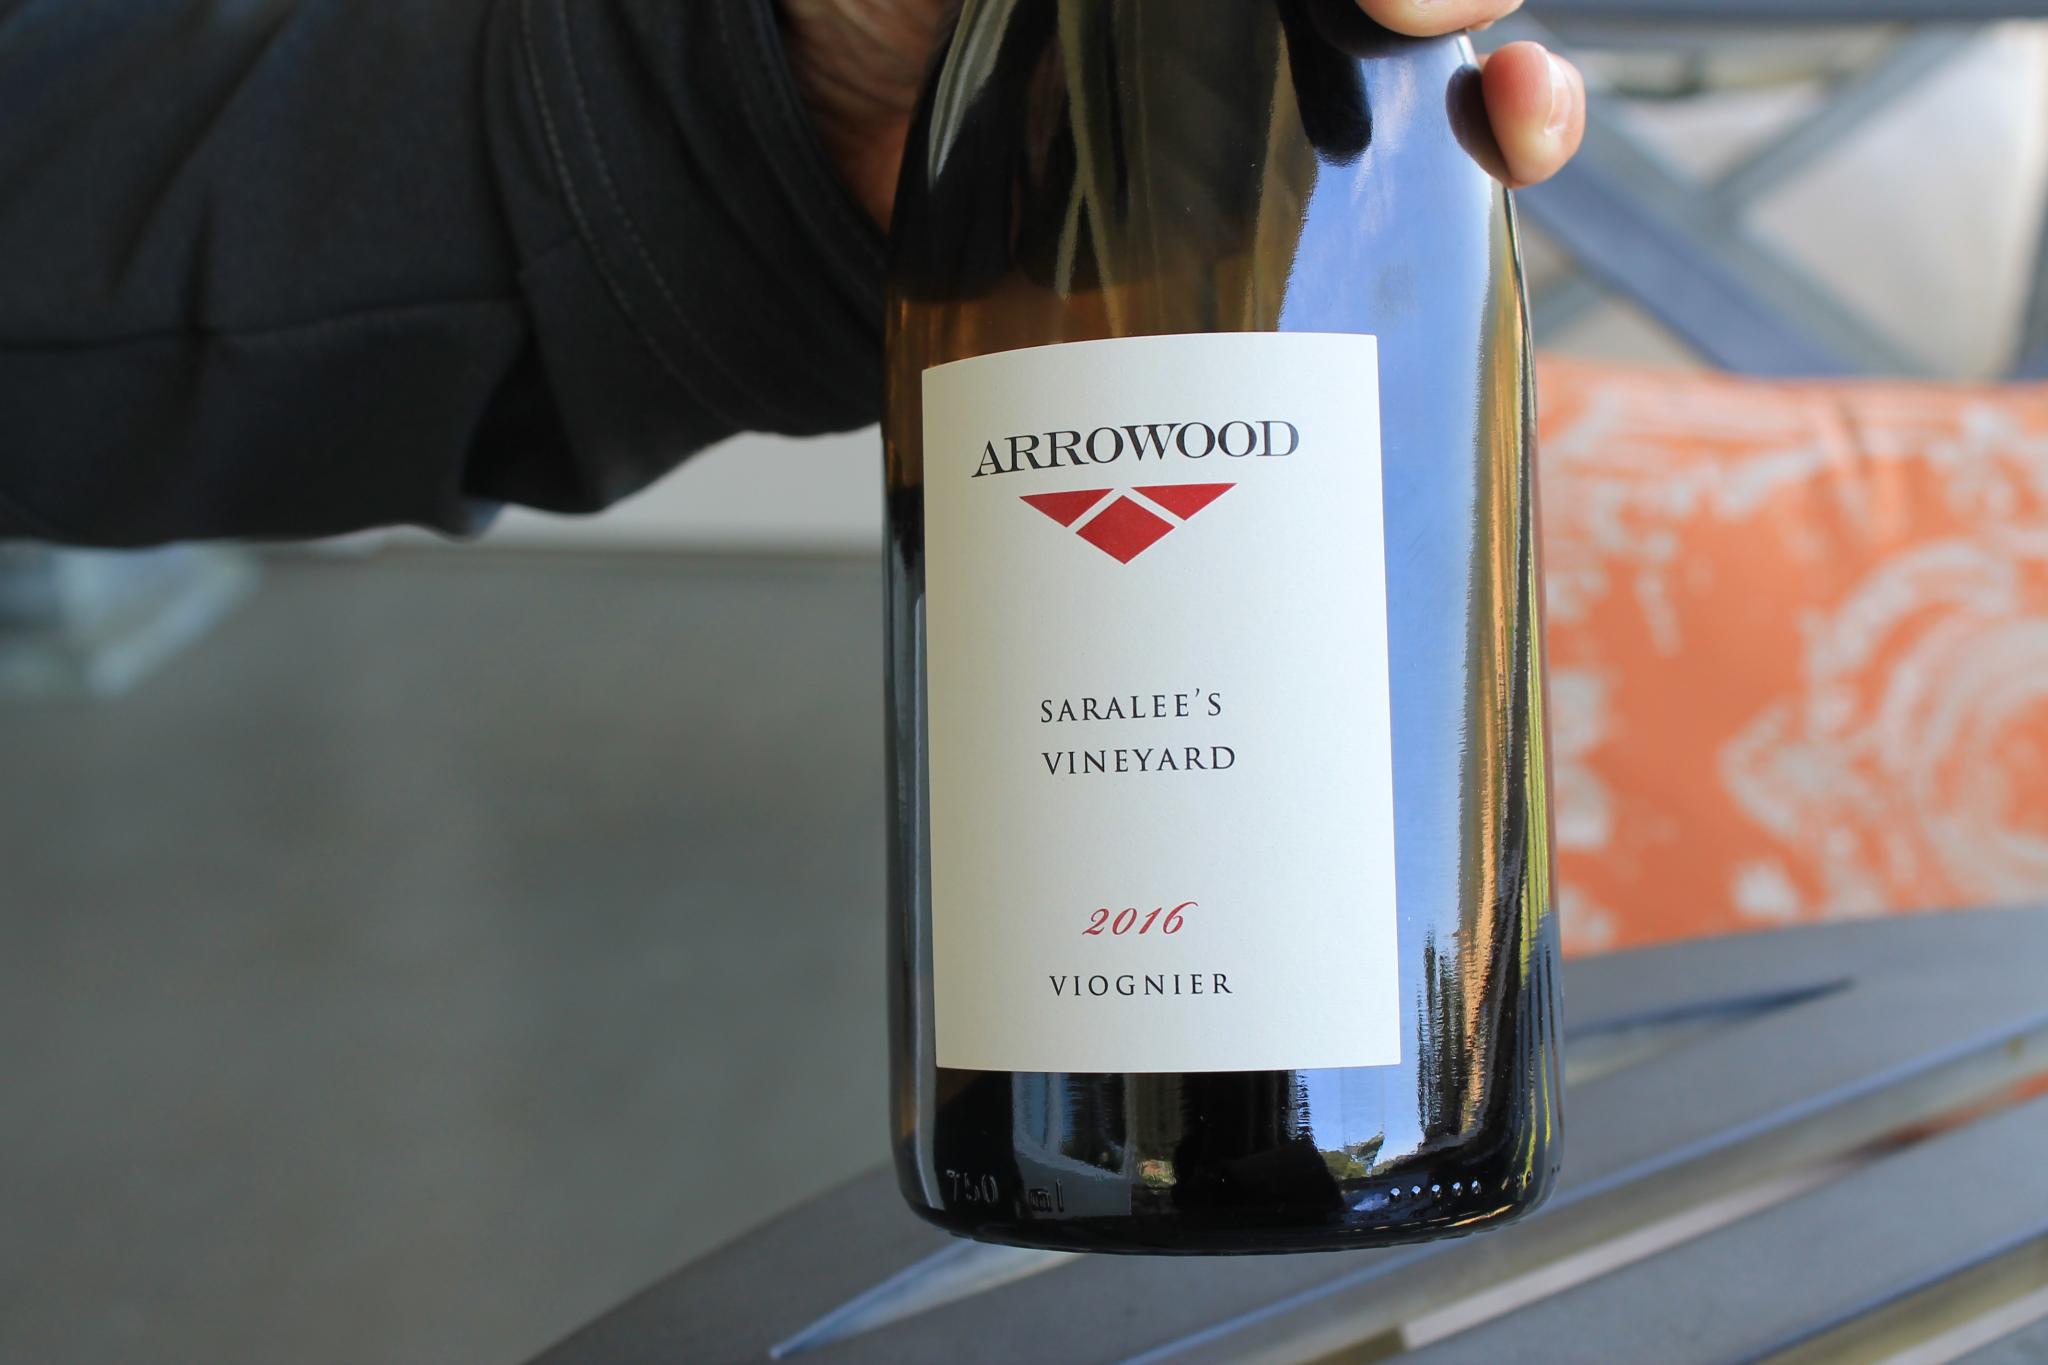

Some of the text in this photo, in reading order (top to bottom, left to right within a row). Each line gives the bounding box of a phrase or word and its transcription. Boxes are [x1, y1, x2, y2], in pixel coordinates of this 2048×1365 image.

[971, 420, 1299, 478] ARROWOOD
[1040, 687, 1222, 724] SARALEE'S
[1041, 746, 1235, 776] VINEYARD
[1082, 901, 1198, 936] 2016
[1049, 973, 1233, 997] VIOGNIER
[946, 1168, 1064, 1212] 750 ml
